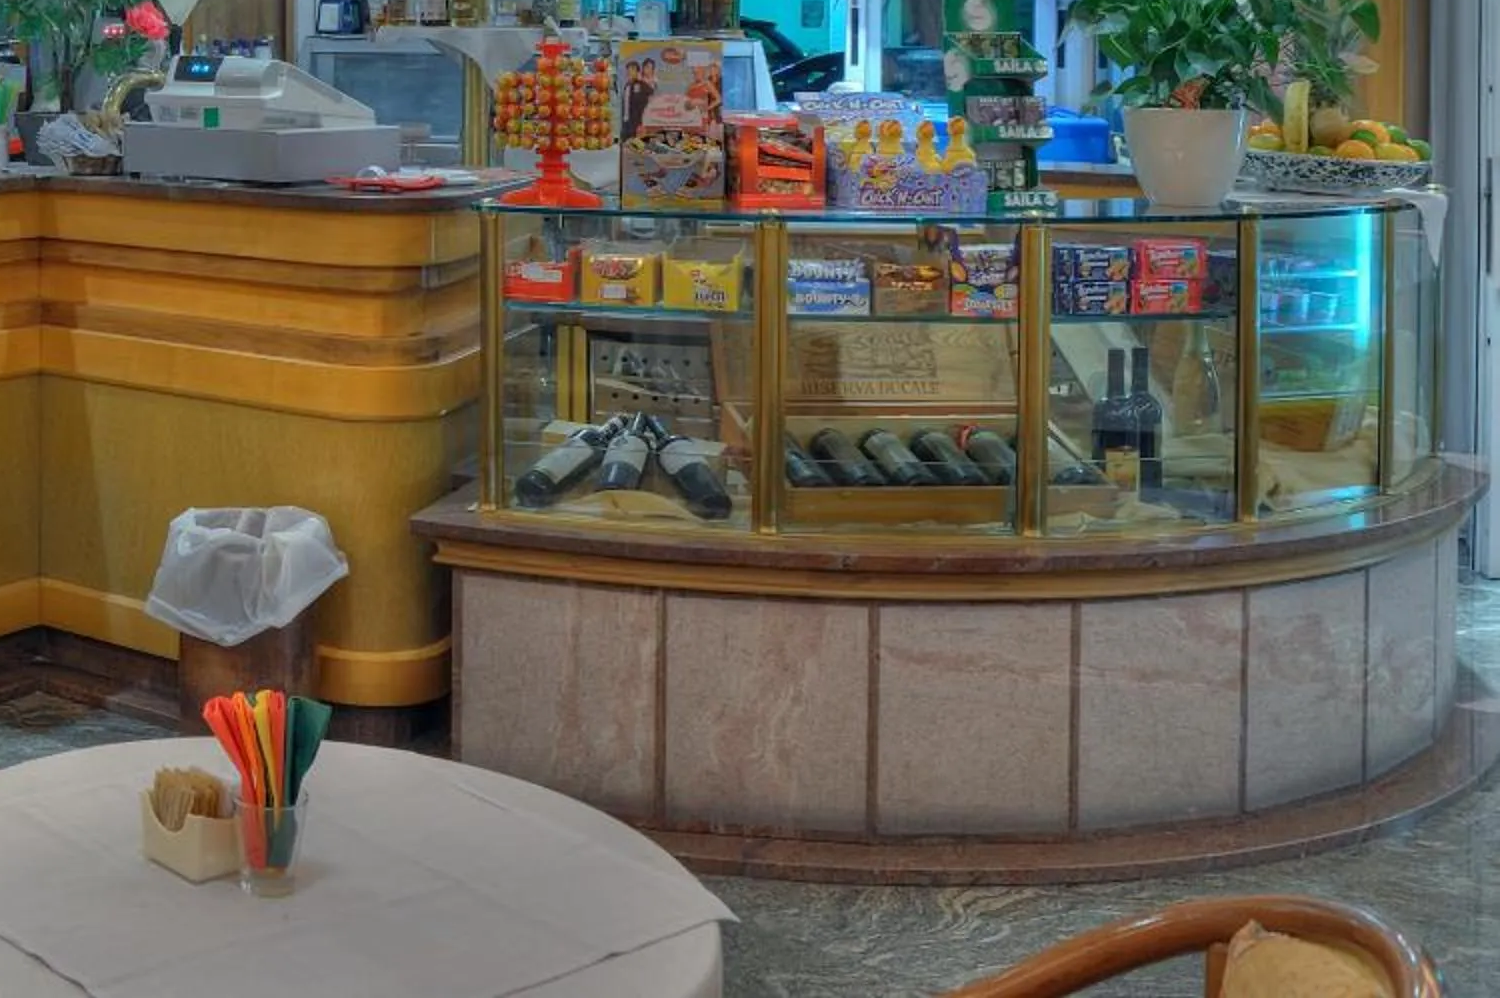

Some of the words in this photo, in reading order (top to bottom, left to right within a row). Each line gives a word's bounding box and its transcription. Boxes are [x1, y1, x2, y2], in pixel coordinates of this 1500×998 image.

[993, 59, 1033, 73] SAILA
[998, 125, 1036, 139] SAILA
[1003, 191, 1043, 207] SAILA
[796, 292, 855, 305] BOUNTY
